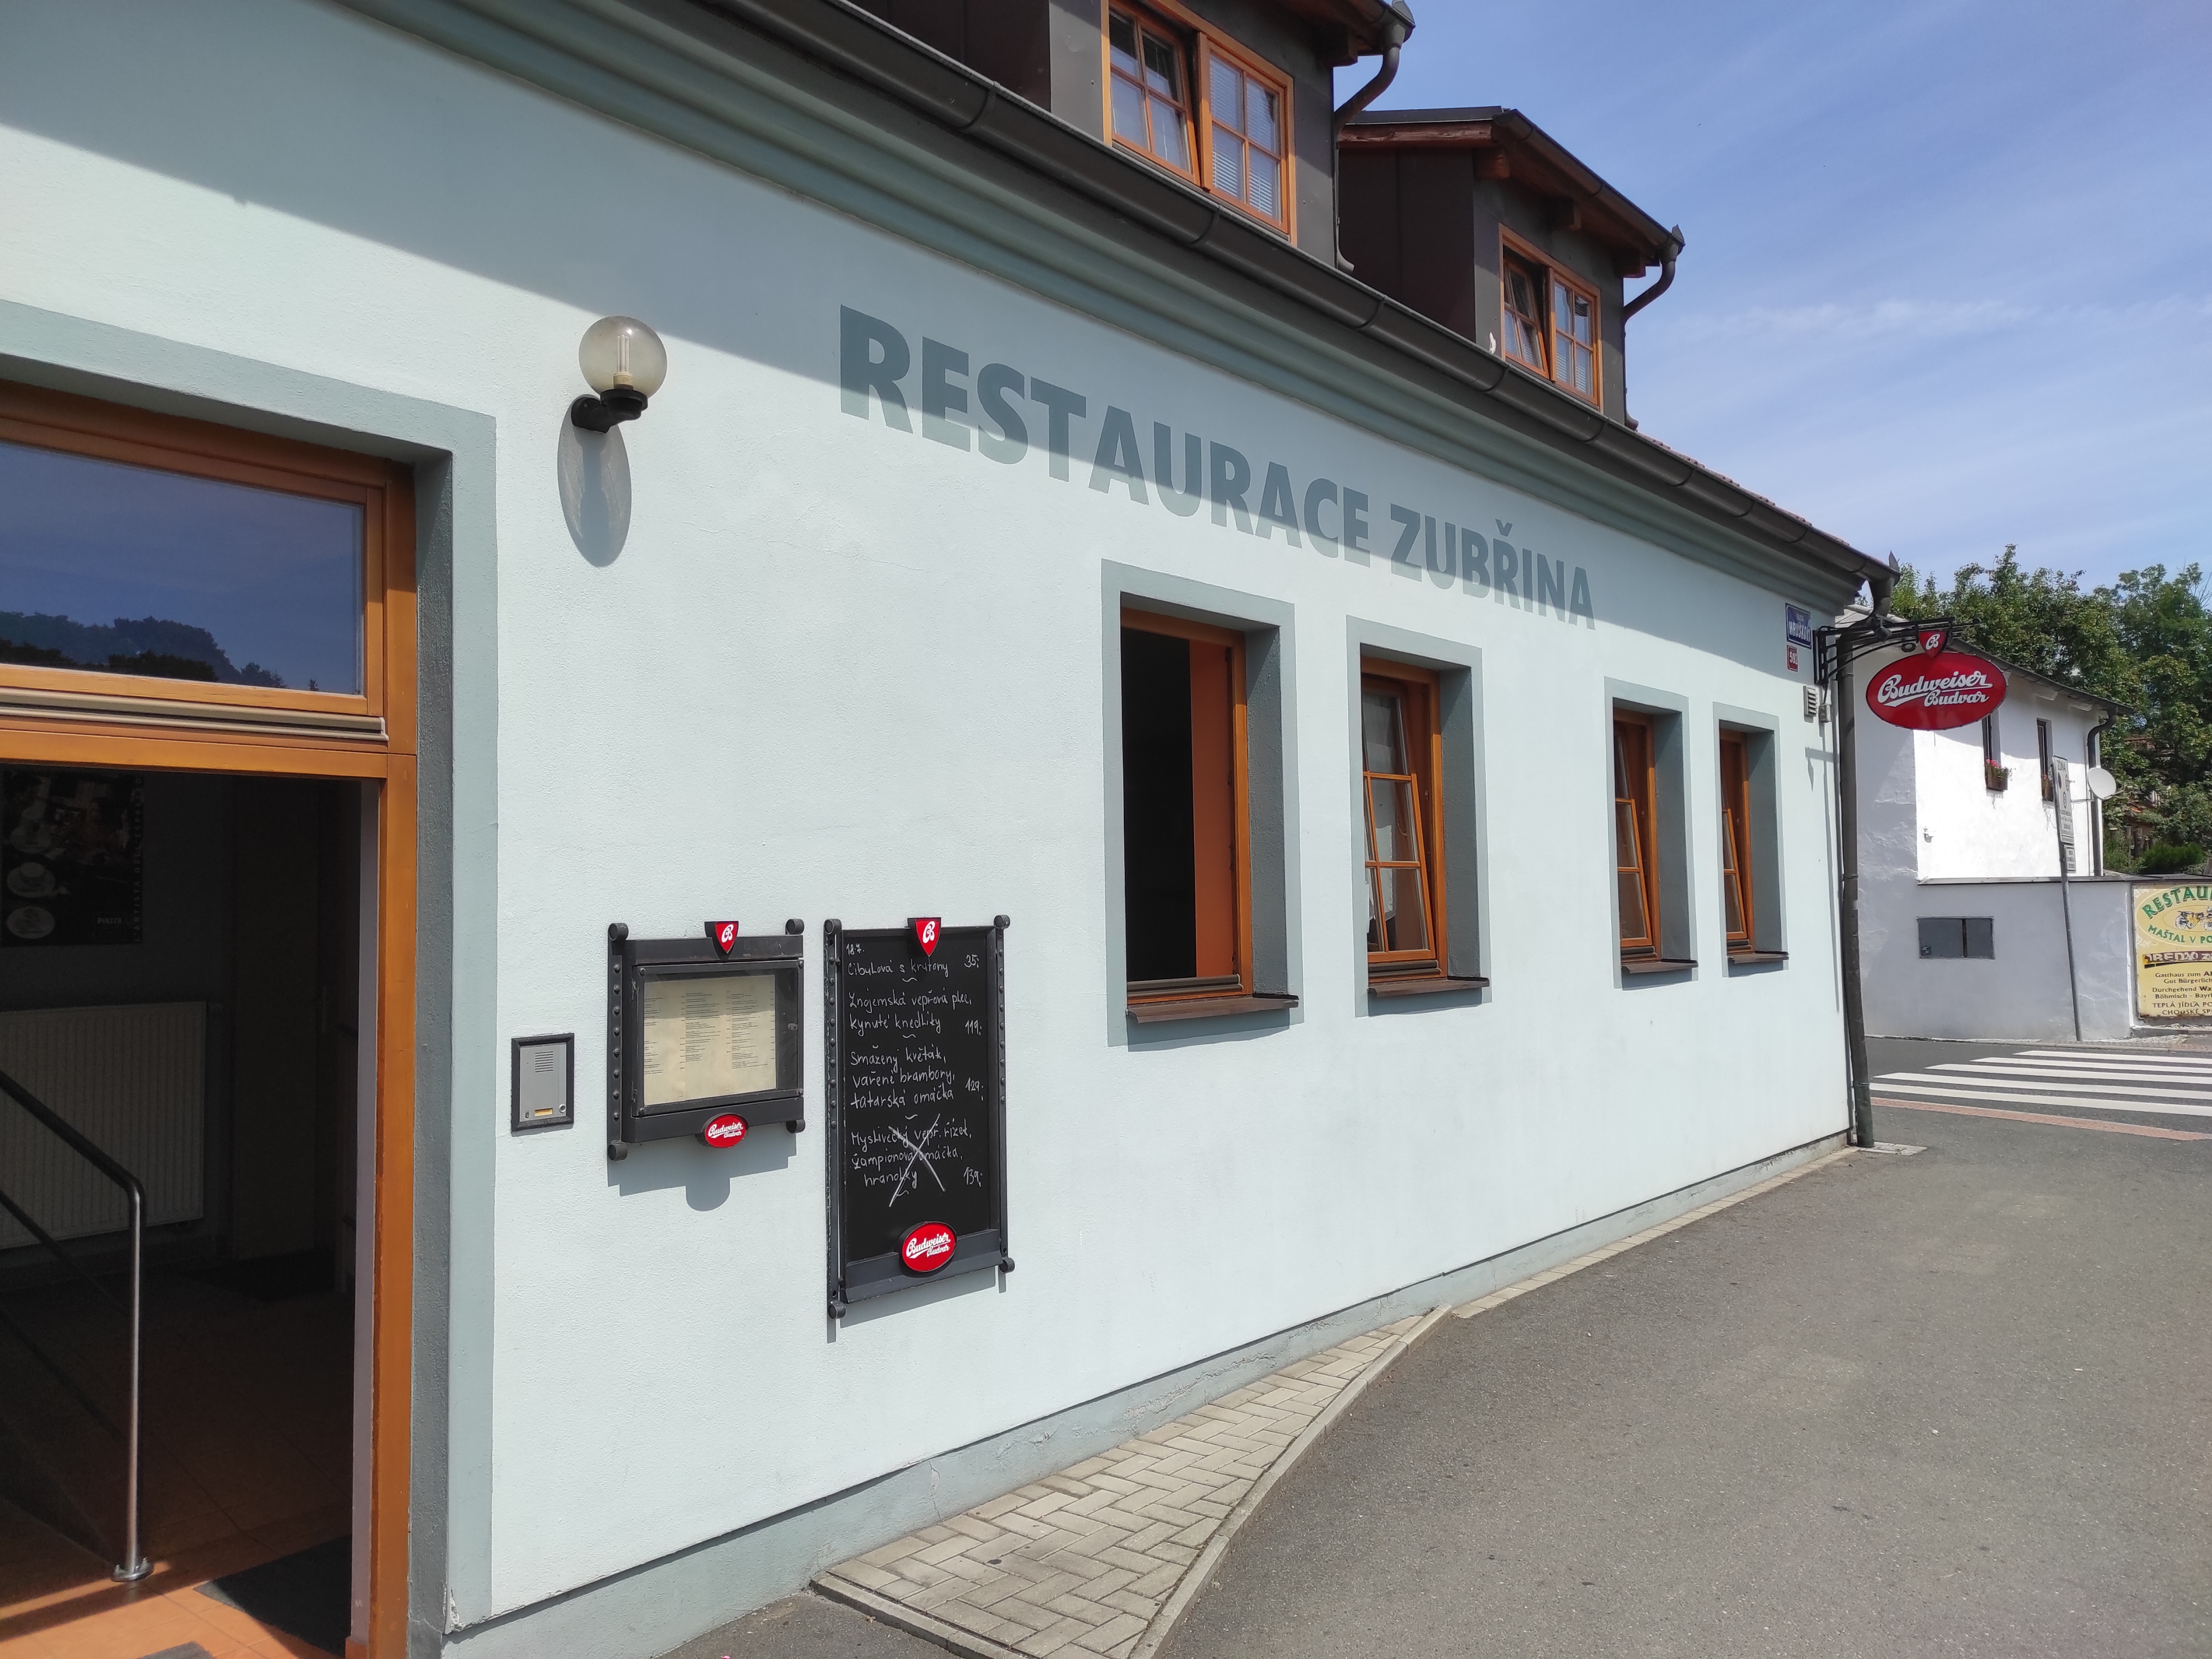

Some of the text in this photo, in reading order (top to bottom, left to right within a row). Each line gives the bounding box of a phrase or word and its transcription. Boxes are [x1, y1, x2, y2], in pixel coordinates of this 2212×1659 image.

[840, 304, 1596, 630] RESTAURACE ZUBŘINA
[1877, 670, 1993, 704] Budweiser
[1924, 690, 1990, 707] Budvar
[2142, 885, 2212, 919] RESTAU
[2147, 924, 2186, 943] MAŠTAL
[899, 964, 905, 973] s
[910, 958, 948, 978] krutony
[848, 988, 906, 1014] Znojemská
[911, 987, 948, 1011] vepřová
[849, 1013, 890, 1037] kynuté
[895, 1010, 941, 1034] knedlíky
[905, 1043, 946, 1064] květák,
[852, 1065, 955, 1088] vařené brambory,
[850, 1088, 906, 1109] tatarská
[914, 1081, 954, 1104] omáčka
[708, 1121, 743, 1137] Budweiser
[906, 1232, 951, 1258] Budweiser
[926, 1244, 950, 1258] Budvar
